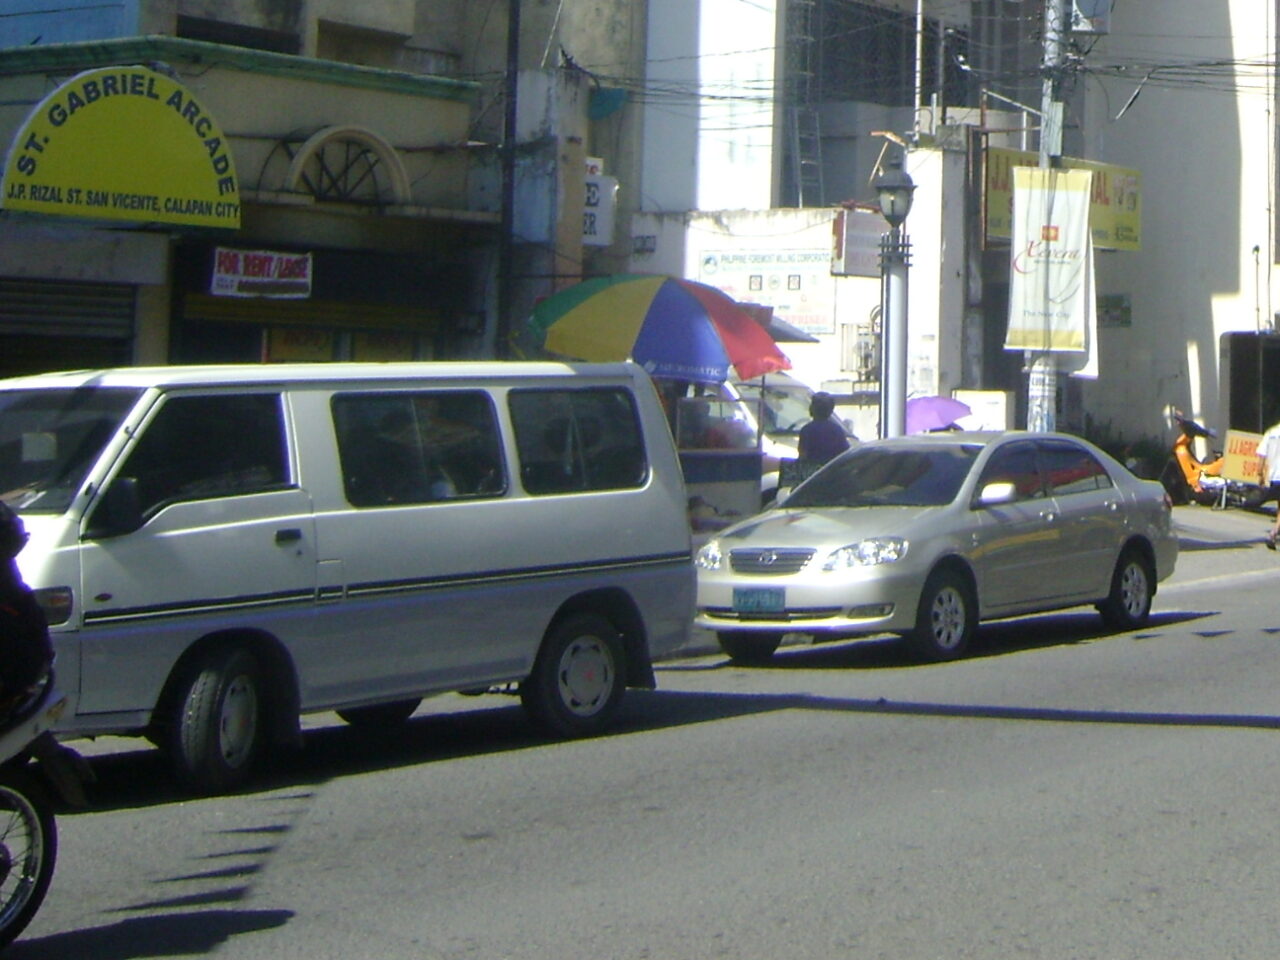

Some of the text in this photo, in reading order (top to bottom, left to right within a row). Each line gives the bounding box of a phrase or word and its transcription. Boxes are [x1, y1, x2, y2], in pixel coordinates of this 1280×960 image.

[17, 74, 236, 196] ST. GABRIEL ARCADE
[7, 184, 241, 218] J.P. RIZAL ST. SAN VICENTE, CALAPAN CITY
